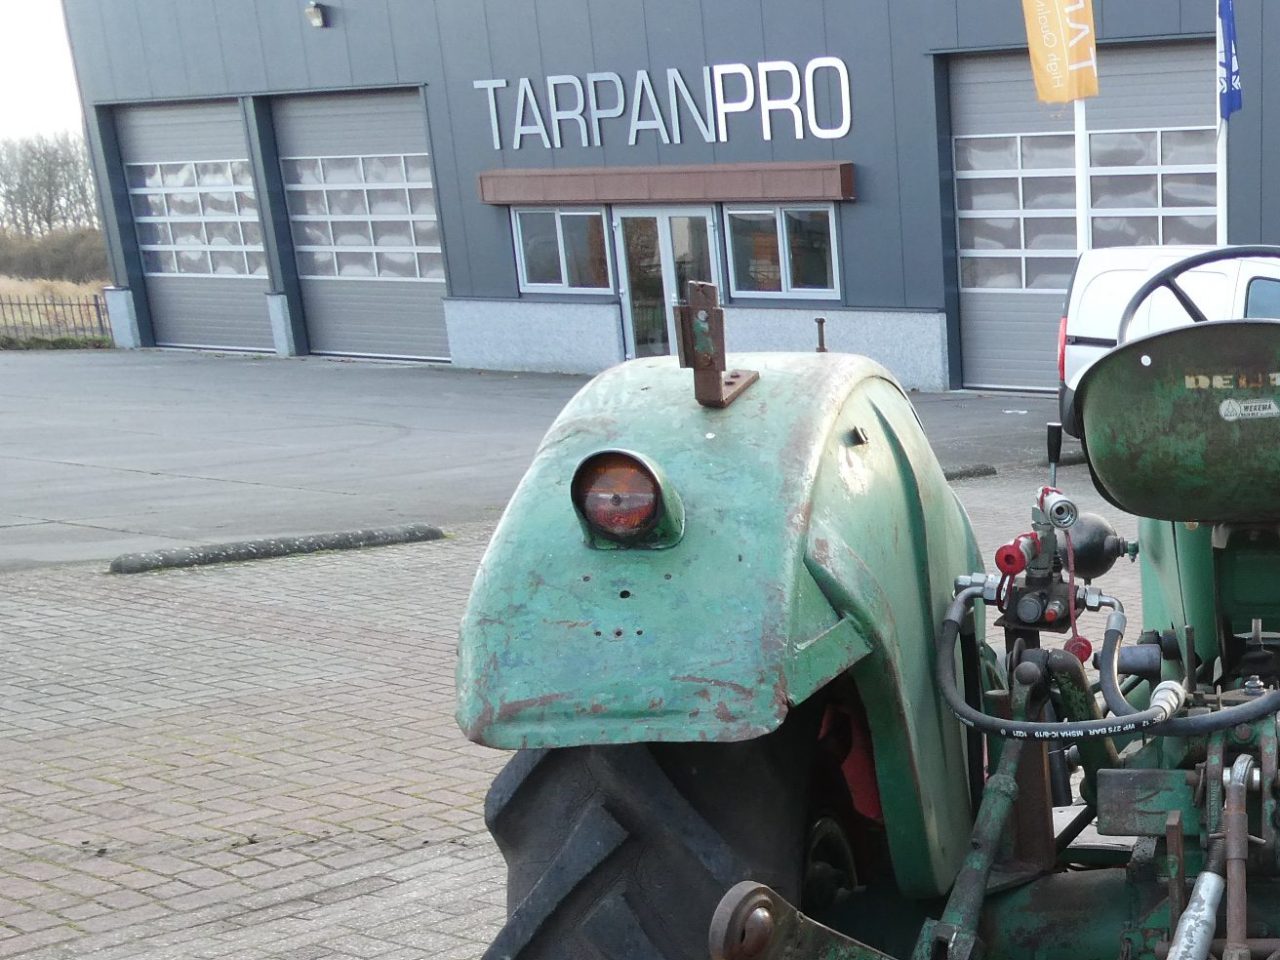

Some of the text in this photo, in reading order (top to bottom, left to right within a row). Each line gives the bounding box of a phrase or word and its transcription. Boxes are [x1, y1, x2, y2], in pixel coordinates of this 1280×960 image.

[473, 56, 852, 150] TARPANPRO
[1108, 725, 1122, 734] 275
[1123, 723, 1136, 731] WP
[1060, 730, 1084, 738] MSHA
[1088, 728, 1107, 736] BAR
